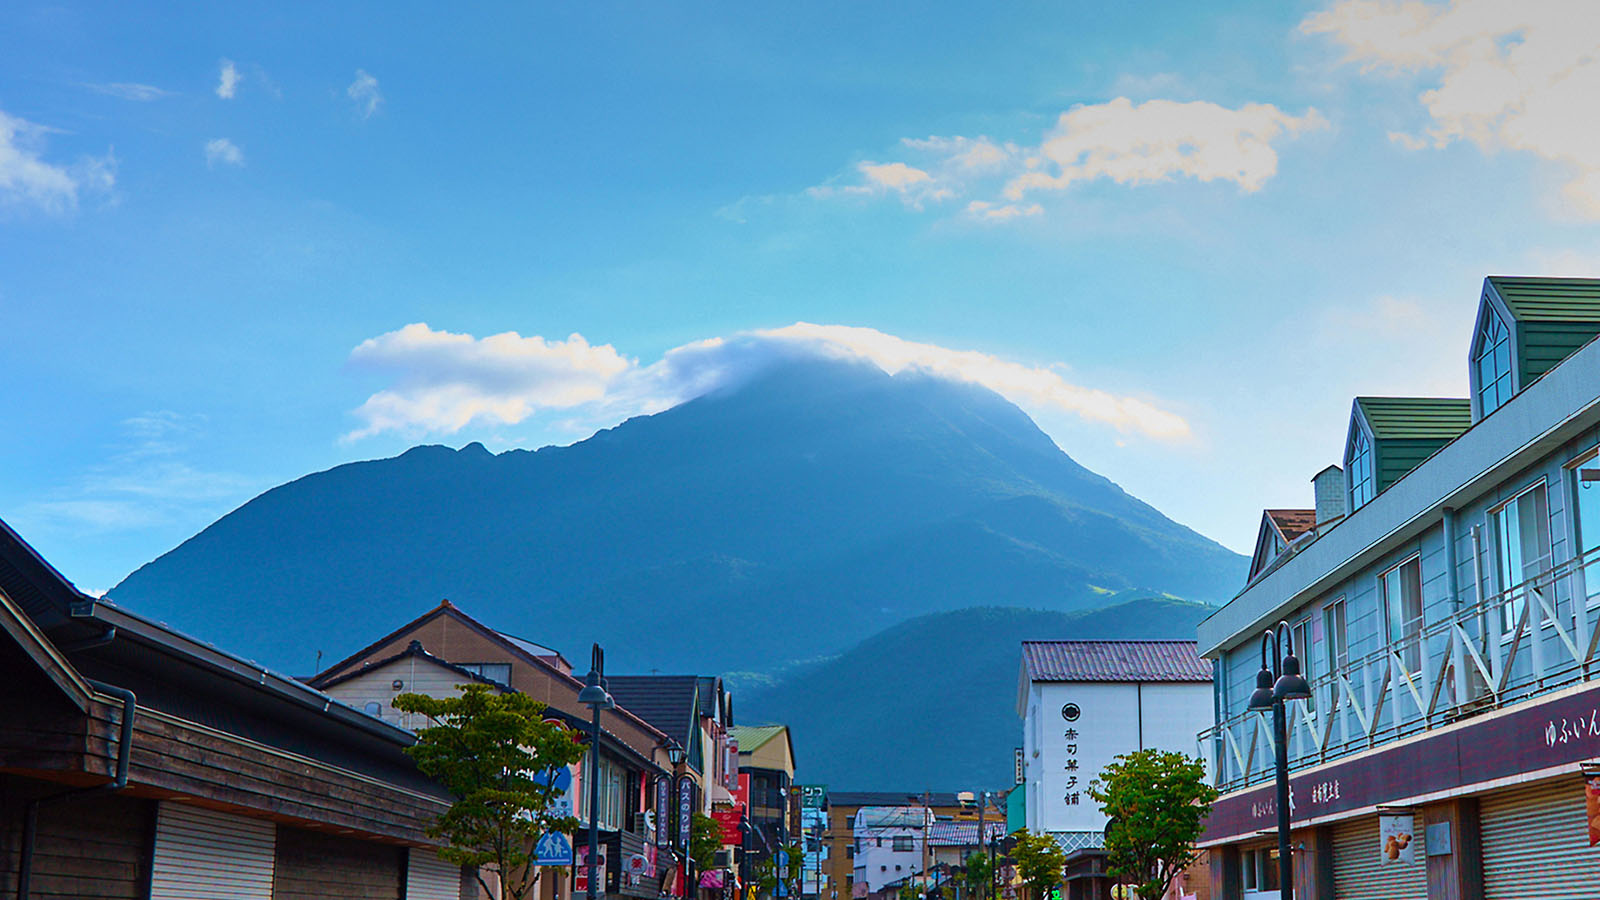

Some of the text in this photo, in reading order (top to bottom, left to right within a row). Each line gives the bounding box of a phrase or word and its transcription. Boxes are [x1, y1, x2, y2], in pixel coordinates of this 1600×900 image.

[681, 782, 690, 832] バスのりば
